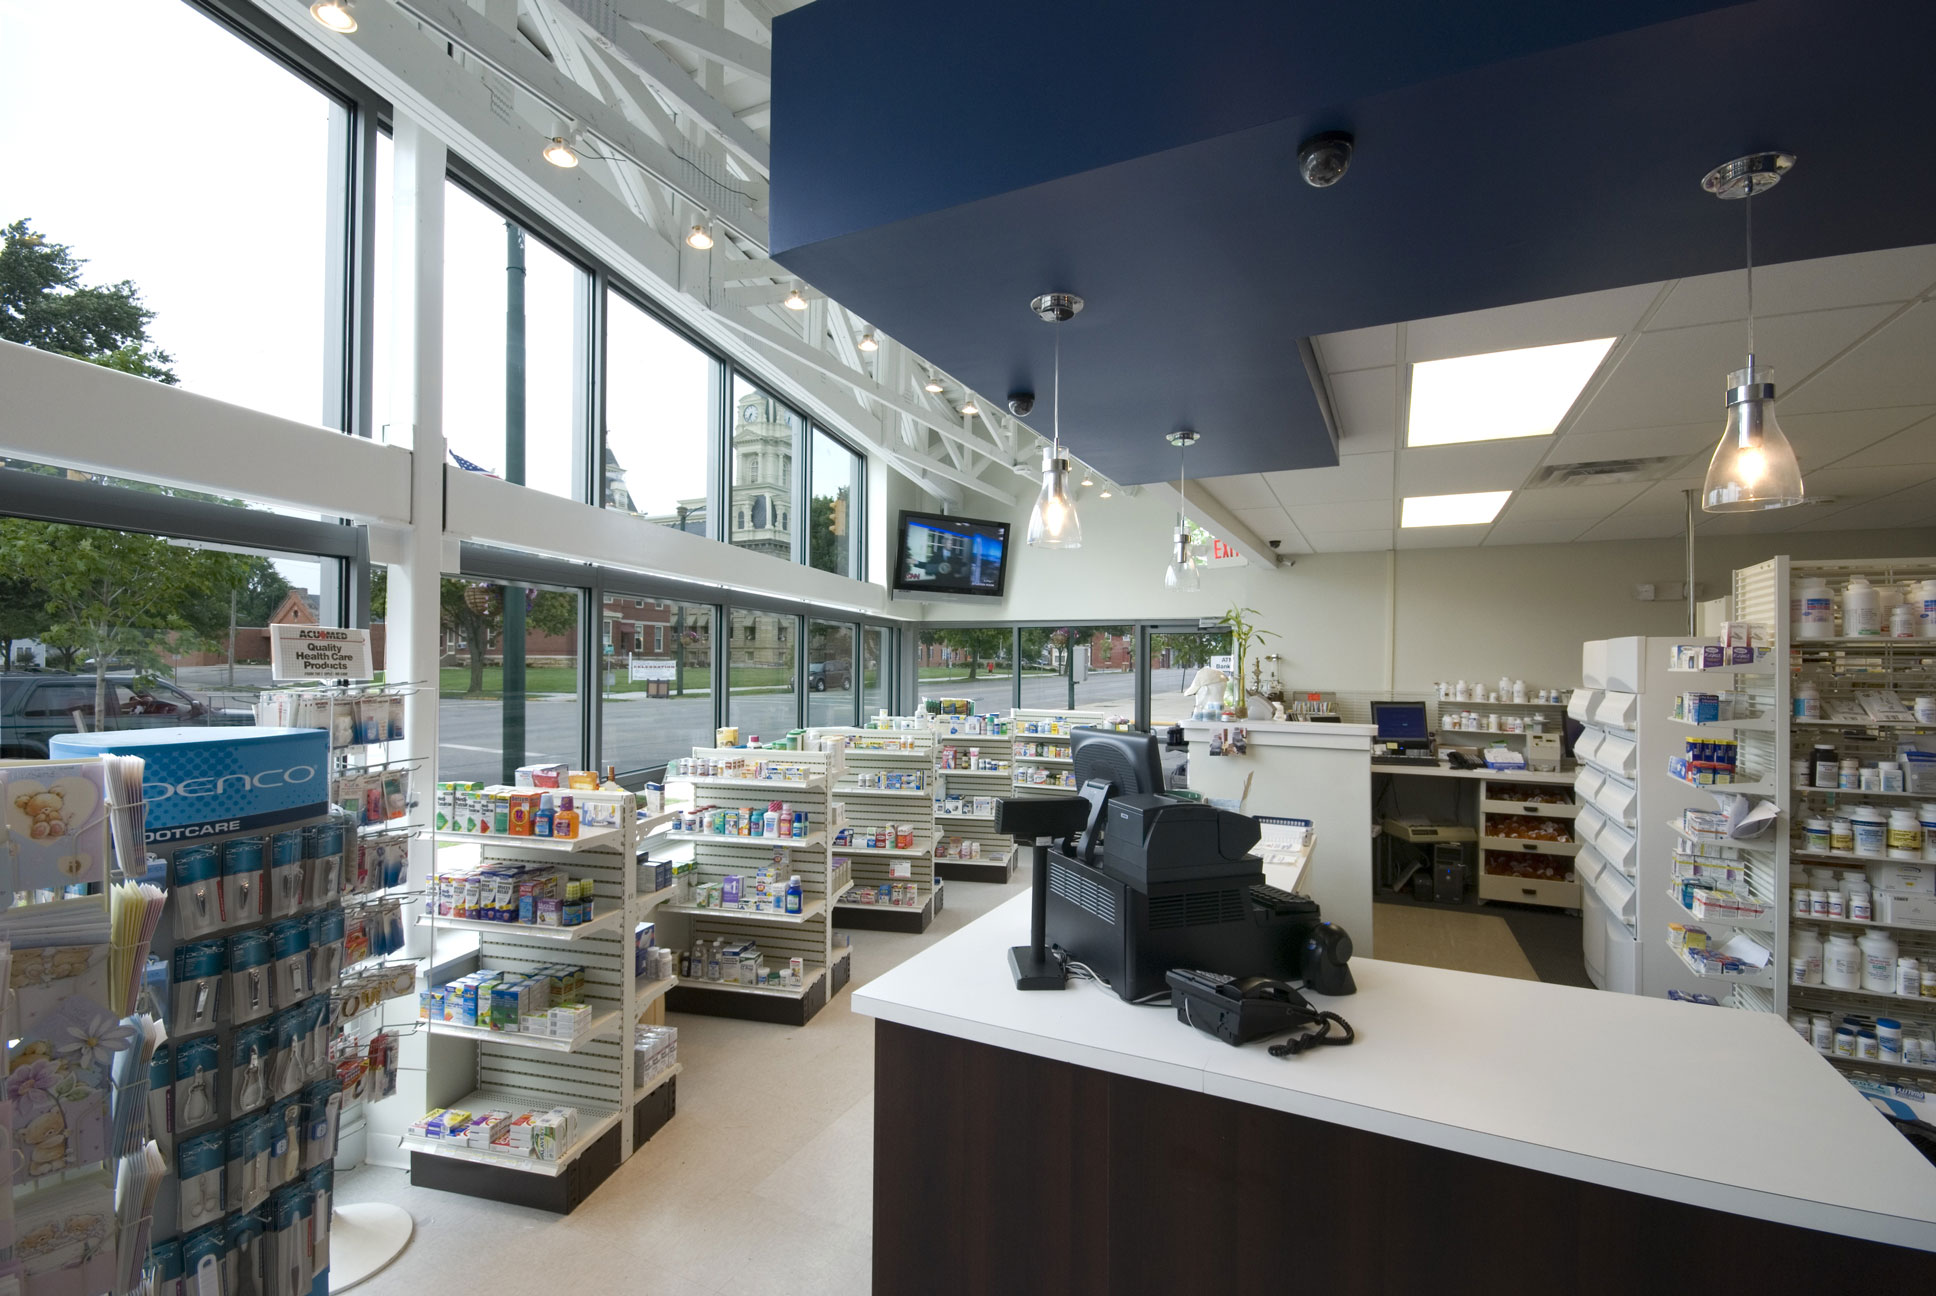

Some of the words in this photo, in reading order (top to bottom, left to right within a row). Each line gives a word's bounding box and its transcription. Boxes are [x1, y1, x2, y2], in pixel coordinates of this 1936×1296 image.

[307, 643, 342, 653] Quality
[296, 651, 330, 660] Health
[331, 653, 353, 661] Care
[303, 661, 348, 670] Products
[142, 765, 315, 802] DENCO
[145, 820, 240, 843] OOTCARE
